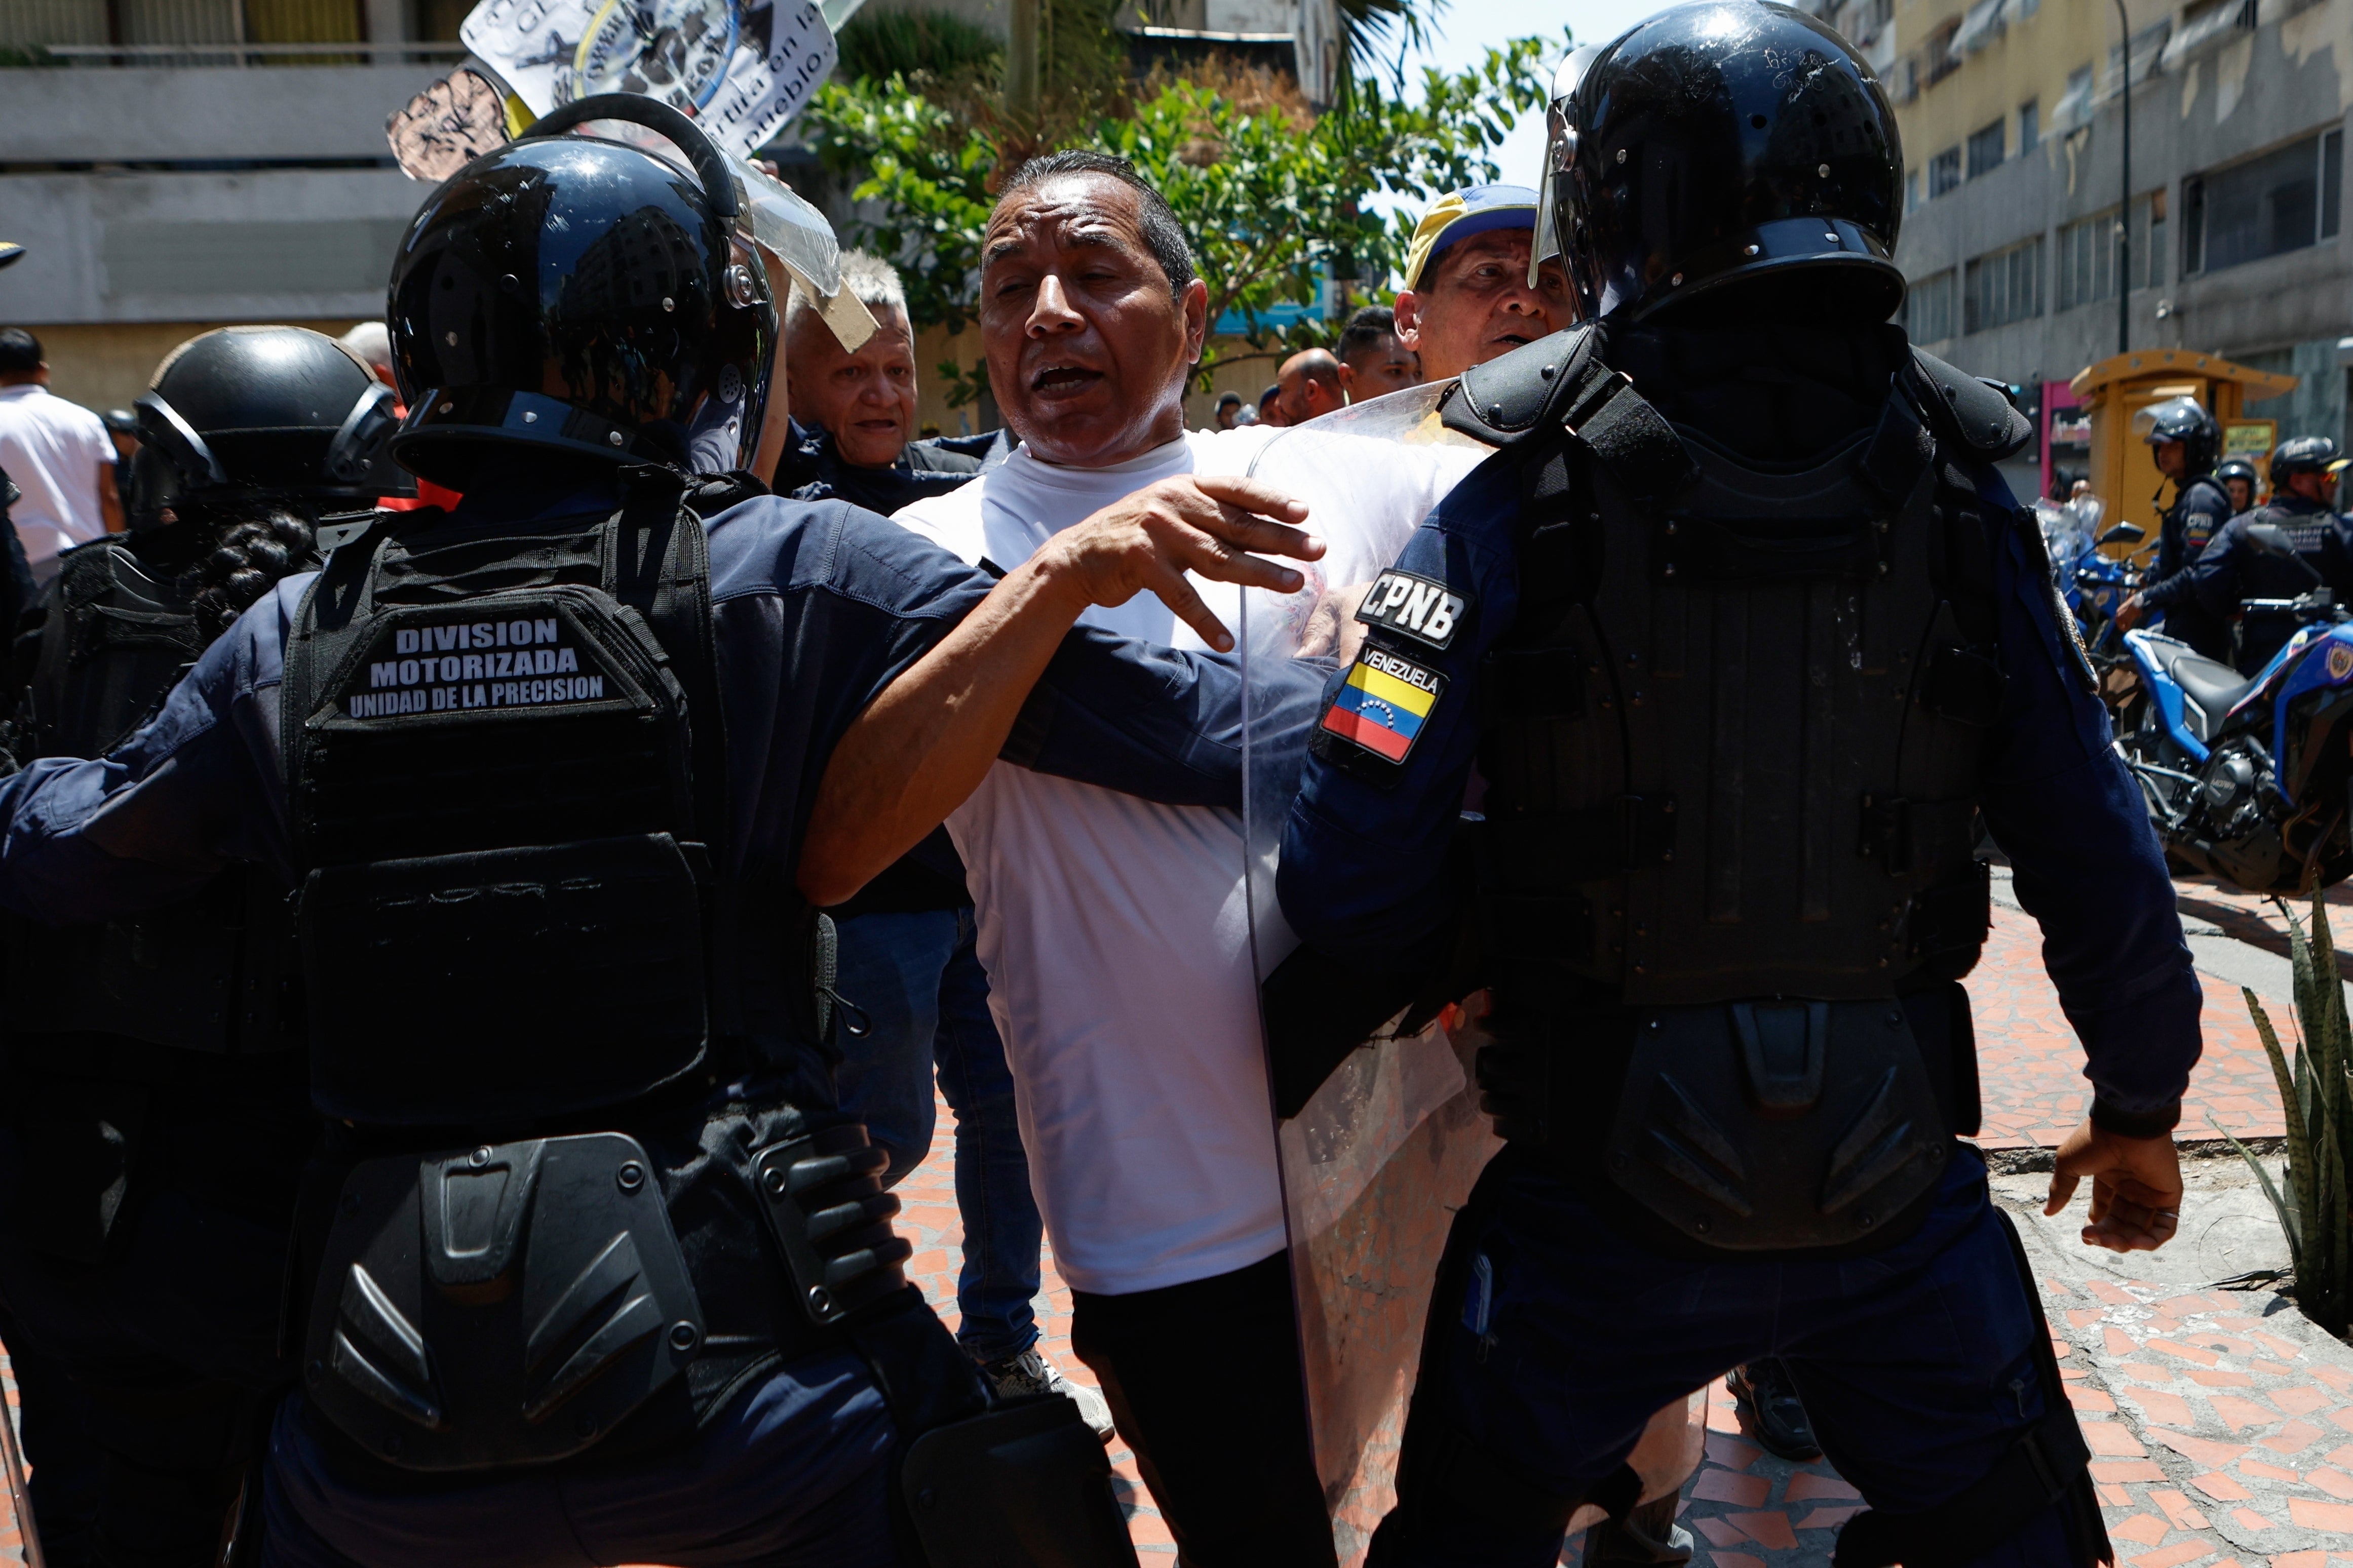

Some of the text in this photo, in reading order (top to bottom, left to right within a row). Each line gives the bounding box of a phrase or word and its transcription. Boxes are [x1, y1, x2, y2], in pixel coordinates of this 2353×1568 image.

[770, 36, 798, 72] en
[795, 3, 818, 30] la
[1361, 574, 1464, 641] CPNB
[397, 618, 557, 654] DIVISION
[371, 648, 578, 688] MOTORIZADA
[1363, 647, 1439, 694] VENEZUELA
[350, 675, 603, 718] UNIDAD DE LA PRECISION
